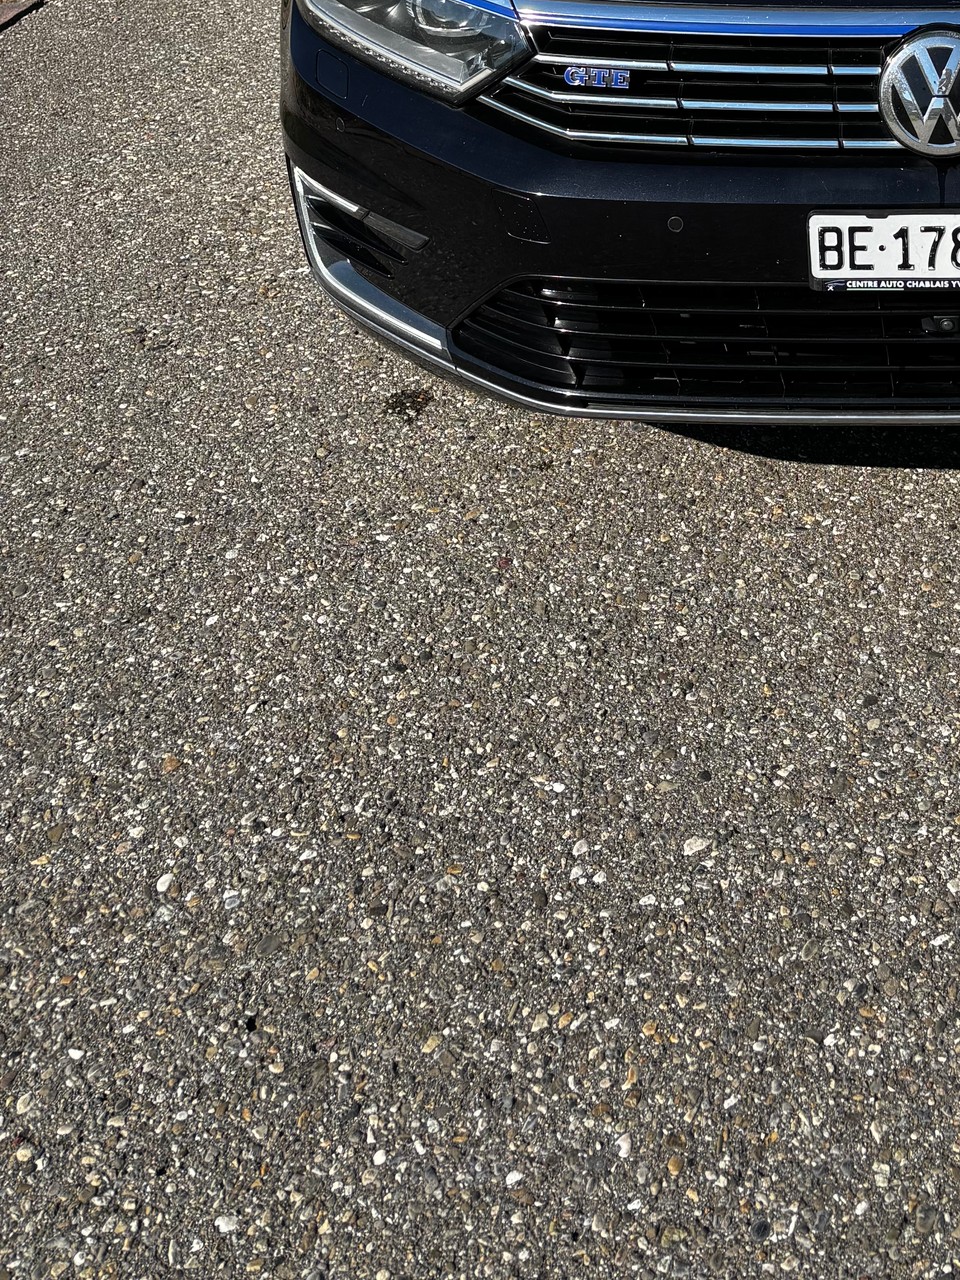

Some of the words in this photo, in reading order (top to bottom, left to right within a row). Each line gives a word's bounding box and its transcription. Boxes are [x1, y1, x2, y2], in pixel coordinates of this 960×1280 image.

[563, 67, 630, 89] GTE
[846, 280, 878, 288] CENTRE
[879, 280, 905, 288] AUTO
[906, 280, 949, 288] CHABLAIS
